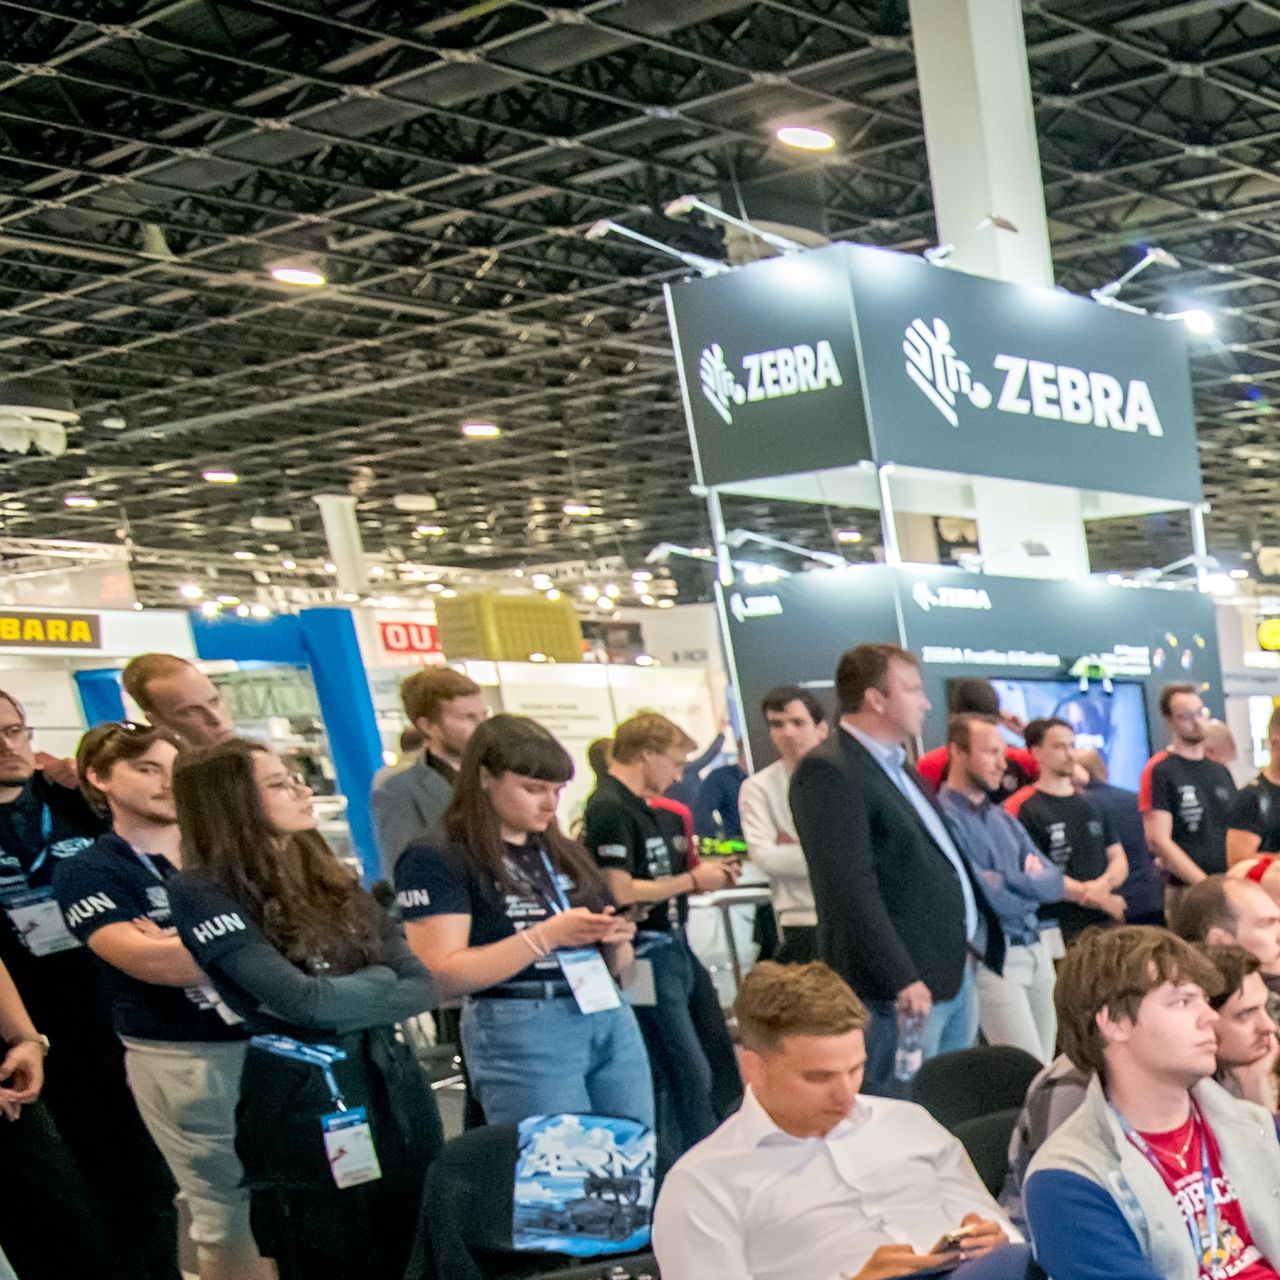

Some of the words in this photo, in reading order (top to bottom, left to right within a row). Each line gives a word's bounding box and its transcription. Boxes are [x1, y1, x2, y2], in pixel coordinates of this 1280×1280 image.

[743, 341, 842, 400] ZEBRA
[993, 355, 1163, 437] ZEBRA
[0, 617, 92, 643] BARA
[66, 891, 117, 928] HUN
[192, 912, 247, 944] HUN
